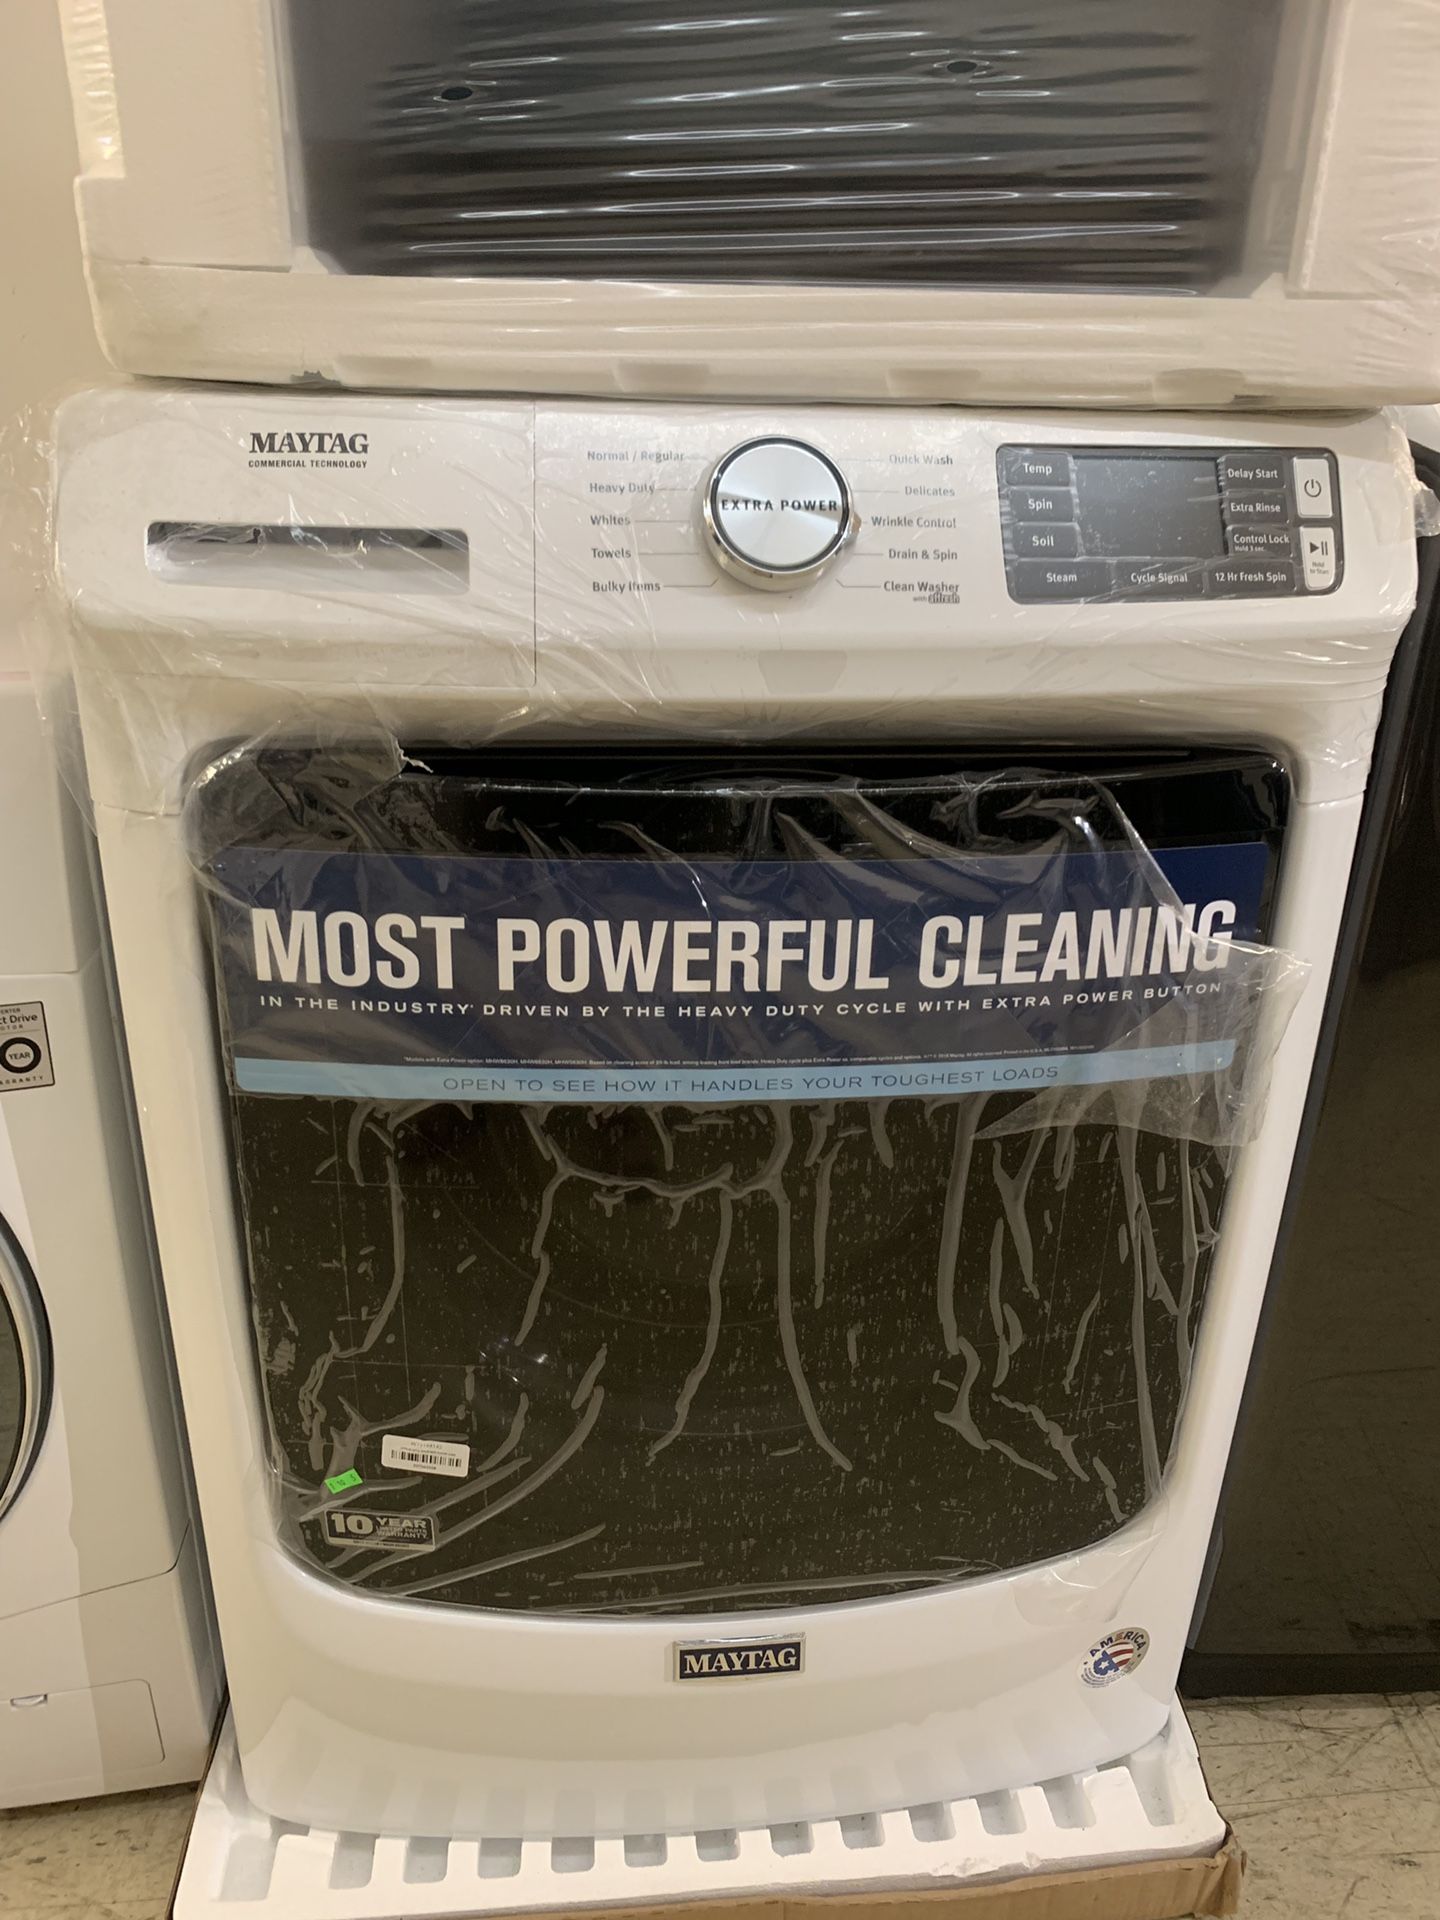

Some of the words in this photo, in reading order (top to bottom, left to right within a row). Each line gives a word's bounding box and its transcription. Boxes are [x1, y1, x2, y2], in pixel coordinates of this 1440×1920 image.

[250, 432, 369, 454] MAYTAG
[588, 451, 629, 461] Normal
[641, 451, 684, 463] Regular
[889, 455, 919, 464] Quick
[923, 455, 953, 465] Wash
[248, 460, 307, 468] COMMERCIAL
[310, 460, 368, 469] TECHNOLOGY
[1023, 463, 1052, 475] Temp
[1228, 468, 1253, 480] Delay
[1256, 468, 1278, 479] Start
[589, 483, 625, 495] Heavy
[629, 483, 655, 495] Duty
[905, 486, 955, 496] Delicates
[721, 500, 773, 511] EXTRA
[781, 499, 837, 511] POWER
[1028, 498, 1053, 511] Spin
[1231, 502, 1253, 512] Extra
[1256, 502, 1281, 512] Rinse
[590, 515, 631, 525] Whites
[871, 516, 913, 527] Wrinkle
[916, 517, 956, 528] Control
[1032, 535, 1054, 546] Soil
[1234, 534, 1267, 543] Control
[1269, 534, 1290, 544] Lock
[592, 548, 631, 558] Towels
[888, 548, 918, 559] Drain
[921, 549, 930, 559] &
[933, 549, 958, 562] Spin
[1046, 573, 1077, 582] Steam
[1131, 573, 1156, 584] Cycle
[1158, 573, 1188, 584] Signal
[1215, 573, 1225, 582] 12
[1227, 573, 1238, 582] Hr
[1240, 573, 1264, 582] Fresh
[1266, 573, 1286, 583] Spin
[592, 581, 625, 593] Bulky
[629, 581, 660, 591] Items
[883, 581, 914, 592] Clean
[917, 581, 960, 592] Washer
[252, 908, 465, 989] MOST
[497, 917, 890, 993] POWERFUL
[918, 899, 1237, 989] CLEANING
[260, 995, 282, 1007] IN
[295, 997, 339, 1010] THE
[483, 1004, 569, 1017] DRIVEN
[582, 1005, 610, 1017] BY
[623, 1006, 665, 1017] THE
[678, 1005, 753, 1017] HEAVY
[766, 1004, 825, 1017] DUTY
[836, 1002, 907, 1015] CYCLE
[918, 999, 970, 1013] WITH
[982, 994, 1052, 1010] EXTRA
[1063, 989, 1133, 1006] POWER
[1143, 982, 1222, 999] BUTTON
[10, 1013, 38, 1024] Drive
[9, 1051, 31, 1060] YEAR
[443, 1077, 506, 1091] OPEN
[515, 1079, 543, 1092] TO
[553, 1080, 595, 1092] SEE
[604, 1080, 656, 1092] HOW
[665, 1080, 682, 1092] IT
[691, 1078, 794, 1093] HANDLES
[802, 1076, 863, 1089] YOUR
[871, 1071, 984, 1087] TOUGHEST
[993, 1066, 1059, 1081] LOADS
[331, 1512, 373, 1535] 10
[376, 1517, 426, 1528] YEAR
[1090, 1631, 1146, 1657] AMERICA
[684, 1648, 797, 1673] MAYTAG
